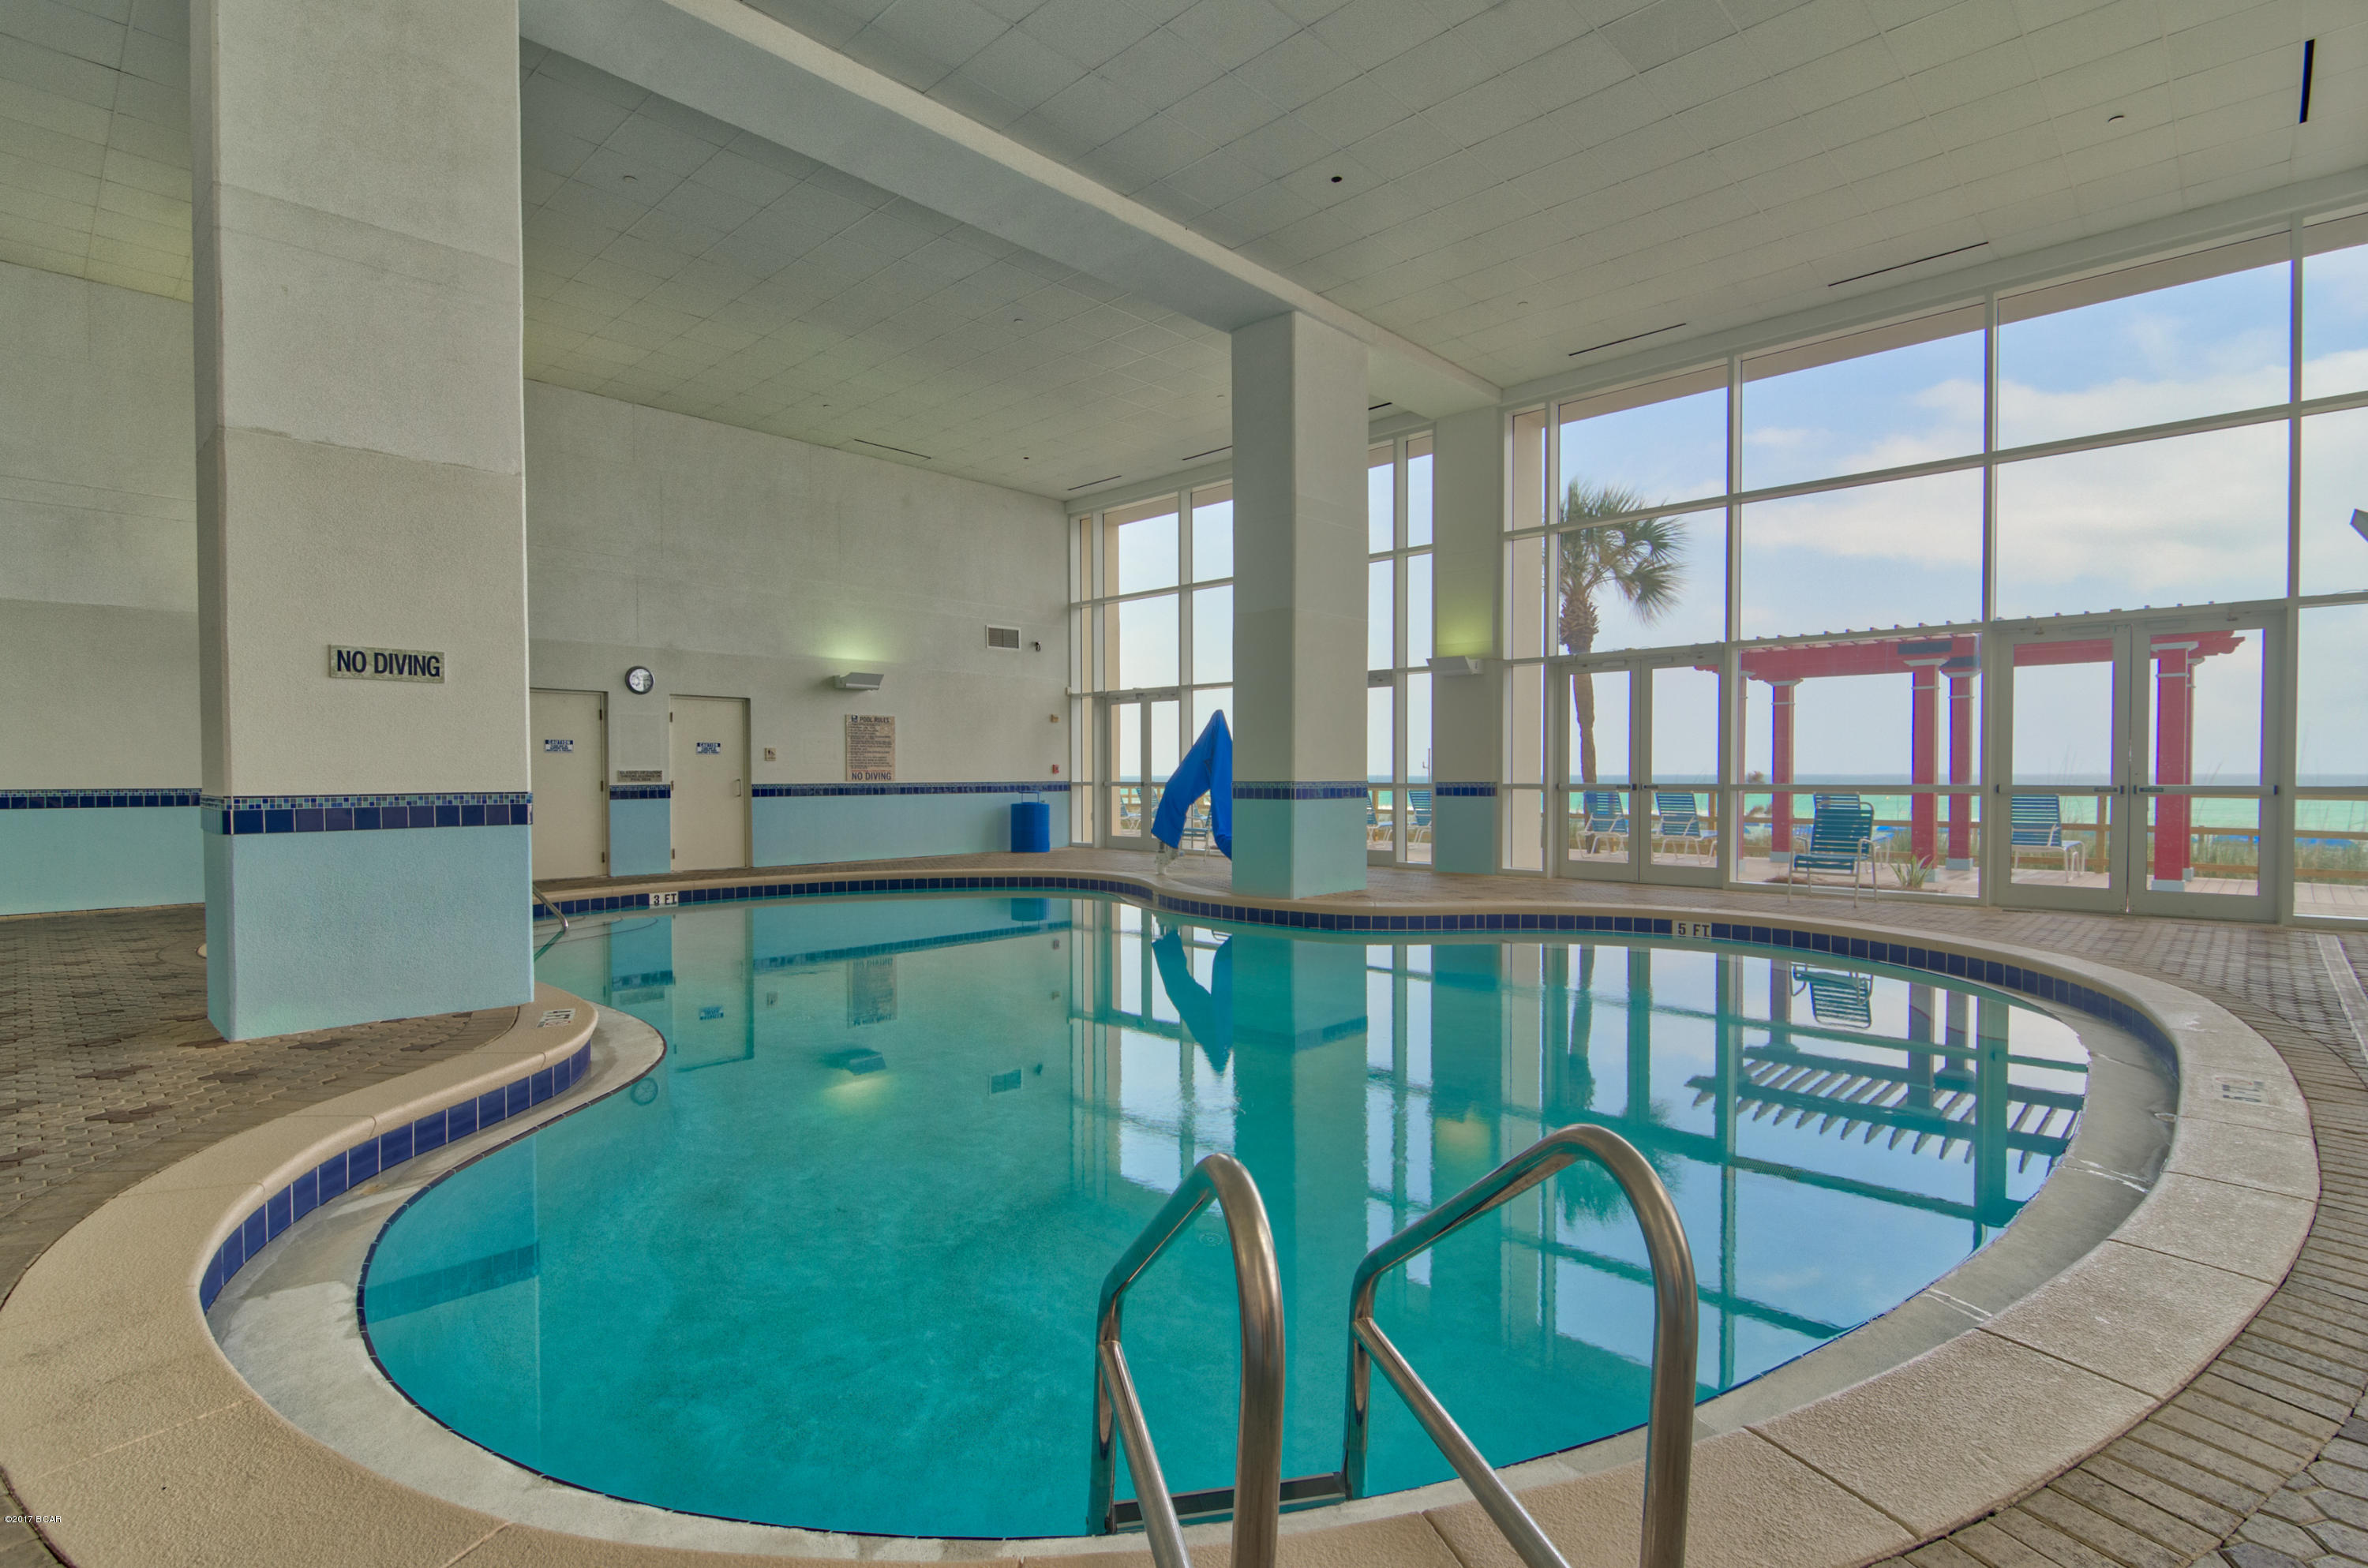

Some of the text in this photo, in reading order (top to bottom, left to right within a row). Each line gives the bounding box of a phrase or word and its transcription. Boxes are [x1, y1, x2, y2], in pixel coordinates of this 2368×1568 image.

[337, 649, 440, 677] NO DIVING
[852, 772, 891, 780] NO DIVING
[654, 893, 676, 907] 3 FT
[1678, 922, 1710, 937] 5 FT
